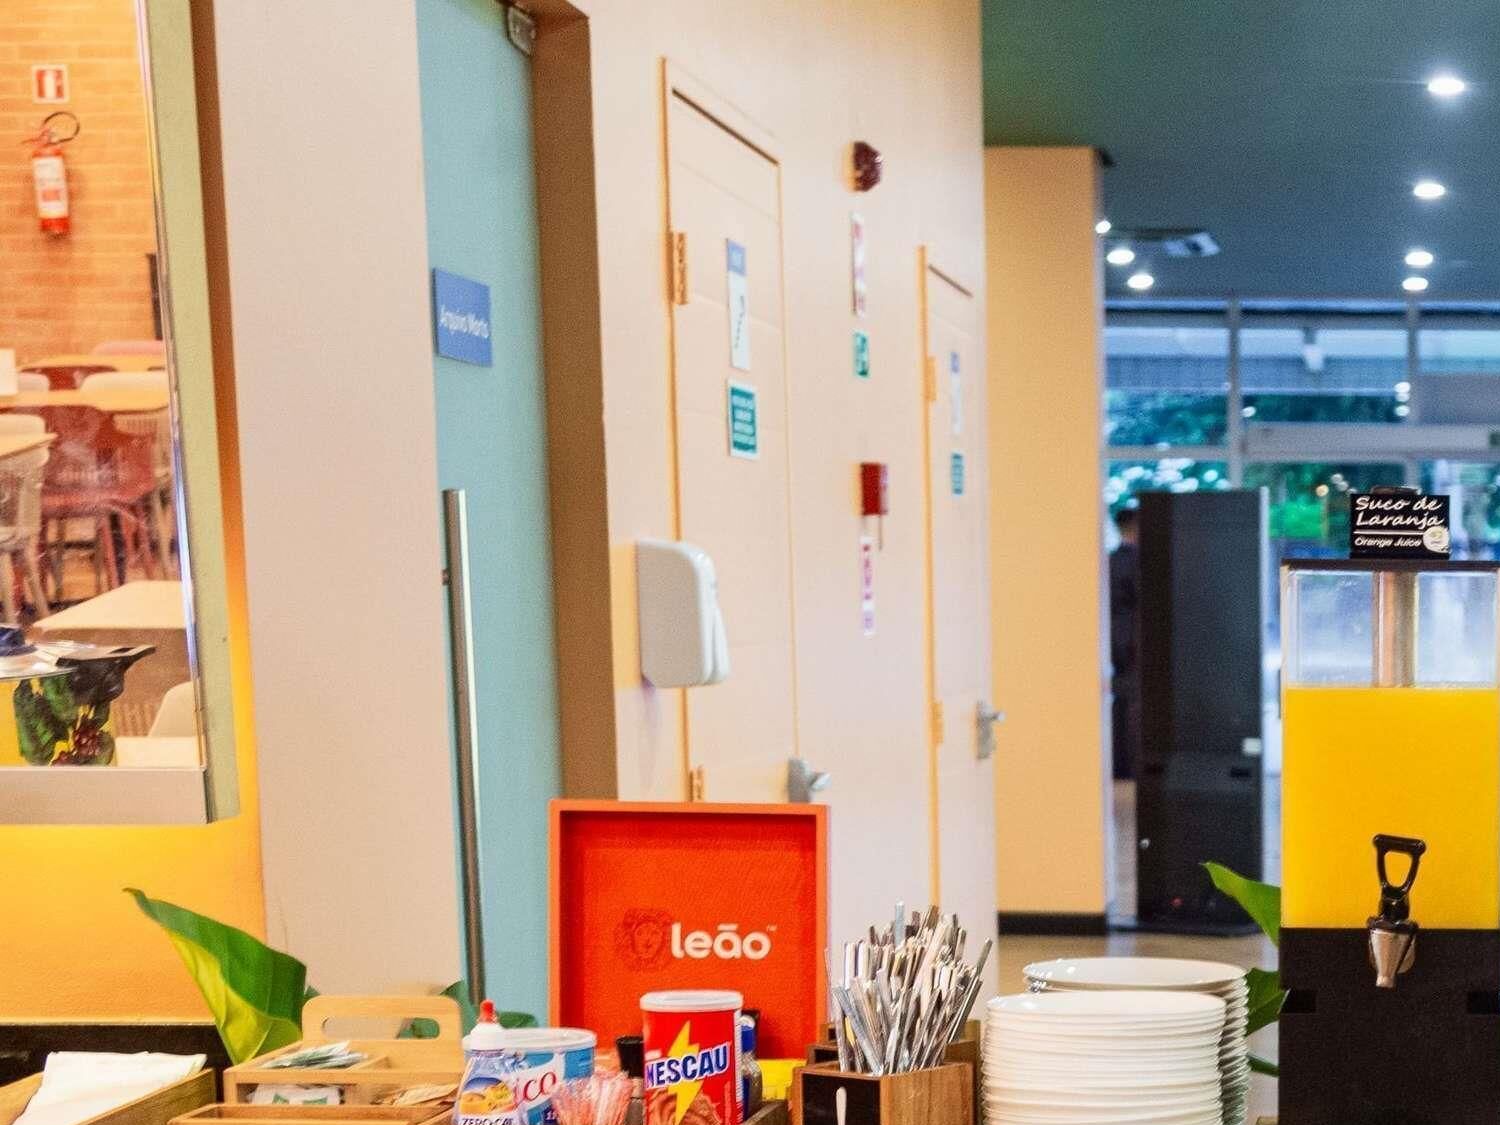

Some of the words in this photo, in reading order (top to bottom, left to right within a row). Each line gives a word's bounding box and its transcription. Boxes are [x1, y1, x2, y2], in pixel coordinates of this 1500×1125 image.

[1355, 496, 1410, 511] Suco
[1413, 496, 1443, 511] de
[1356, 512, 1444, 530] Laranja
[1354, 537, 1393, 548] Orange
[1394, 537, 1422, 548] Juice
[671, 922, 772, 960] leão
[645, 1043, 730, 1087] NESCAU
